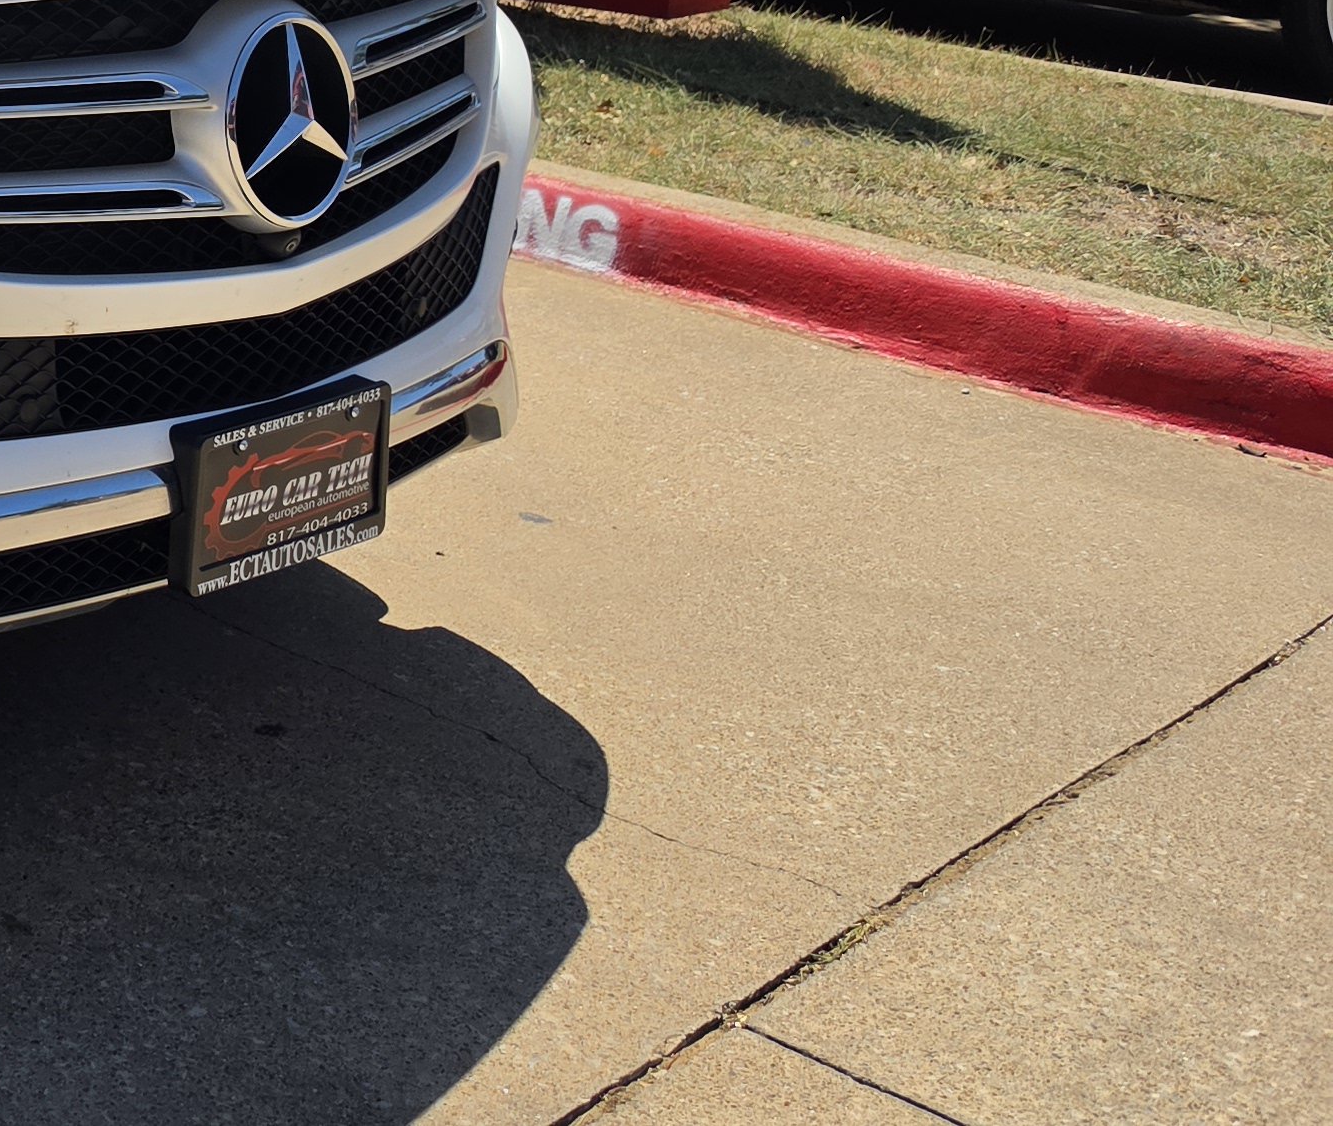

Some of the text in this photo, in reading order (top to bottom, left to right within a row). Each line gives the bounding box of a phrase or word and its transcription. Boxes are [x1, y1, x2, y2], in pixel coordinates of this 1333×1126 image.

[512, 188, 620, 272] NG
[213, 387, 381, 448] SALES & SERVICE 817-404-4033
[219, 452, 374, 526] EURO CAR TECH
[267, 480, 370, 522] european automotive
[266, 502, 369, 546] 817-404-4033
[197, 523, 380, 596] www.ECTAUTOSALES.com
